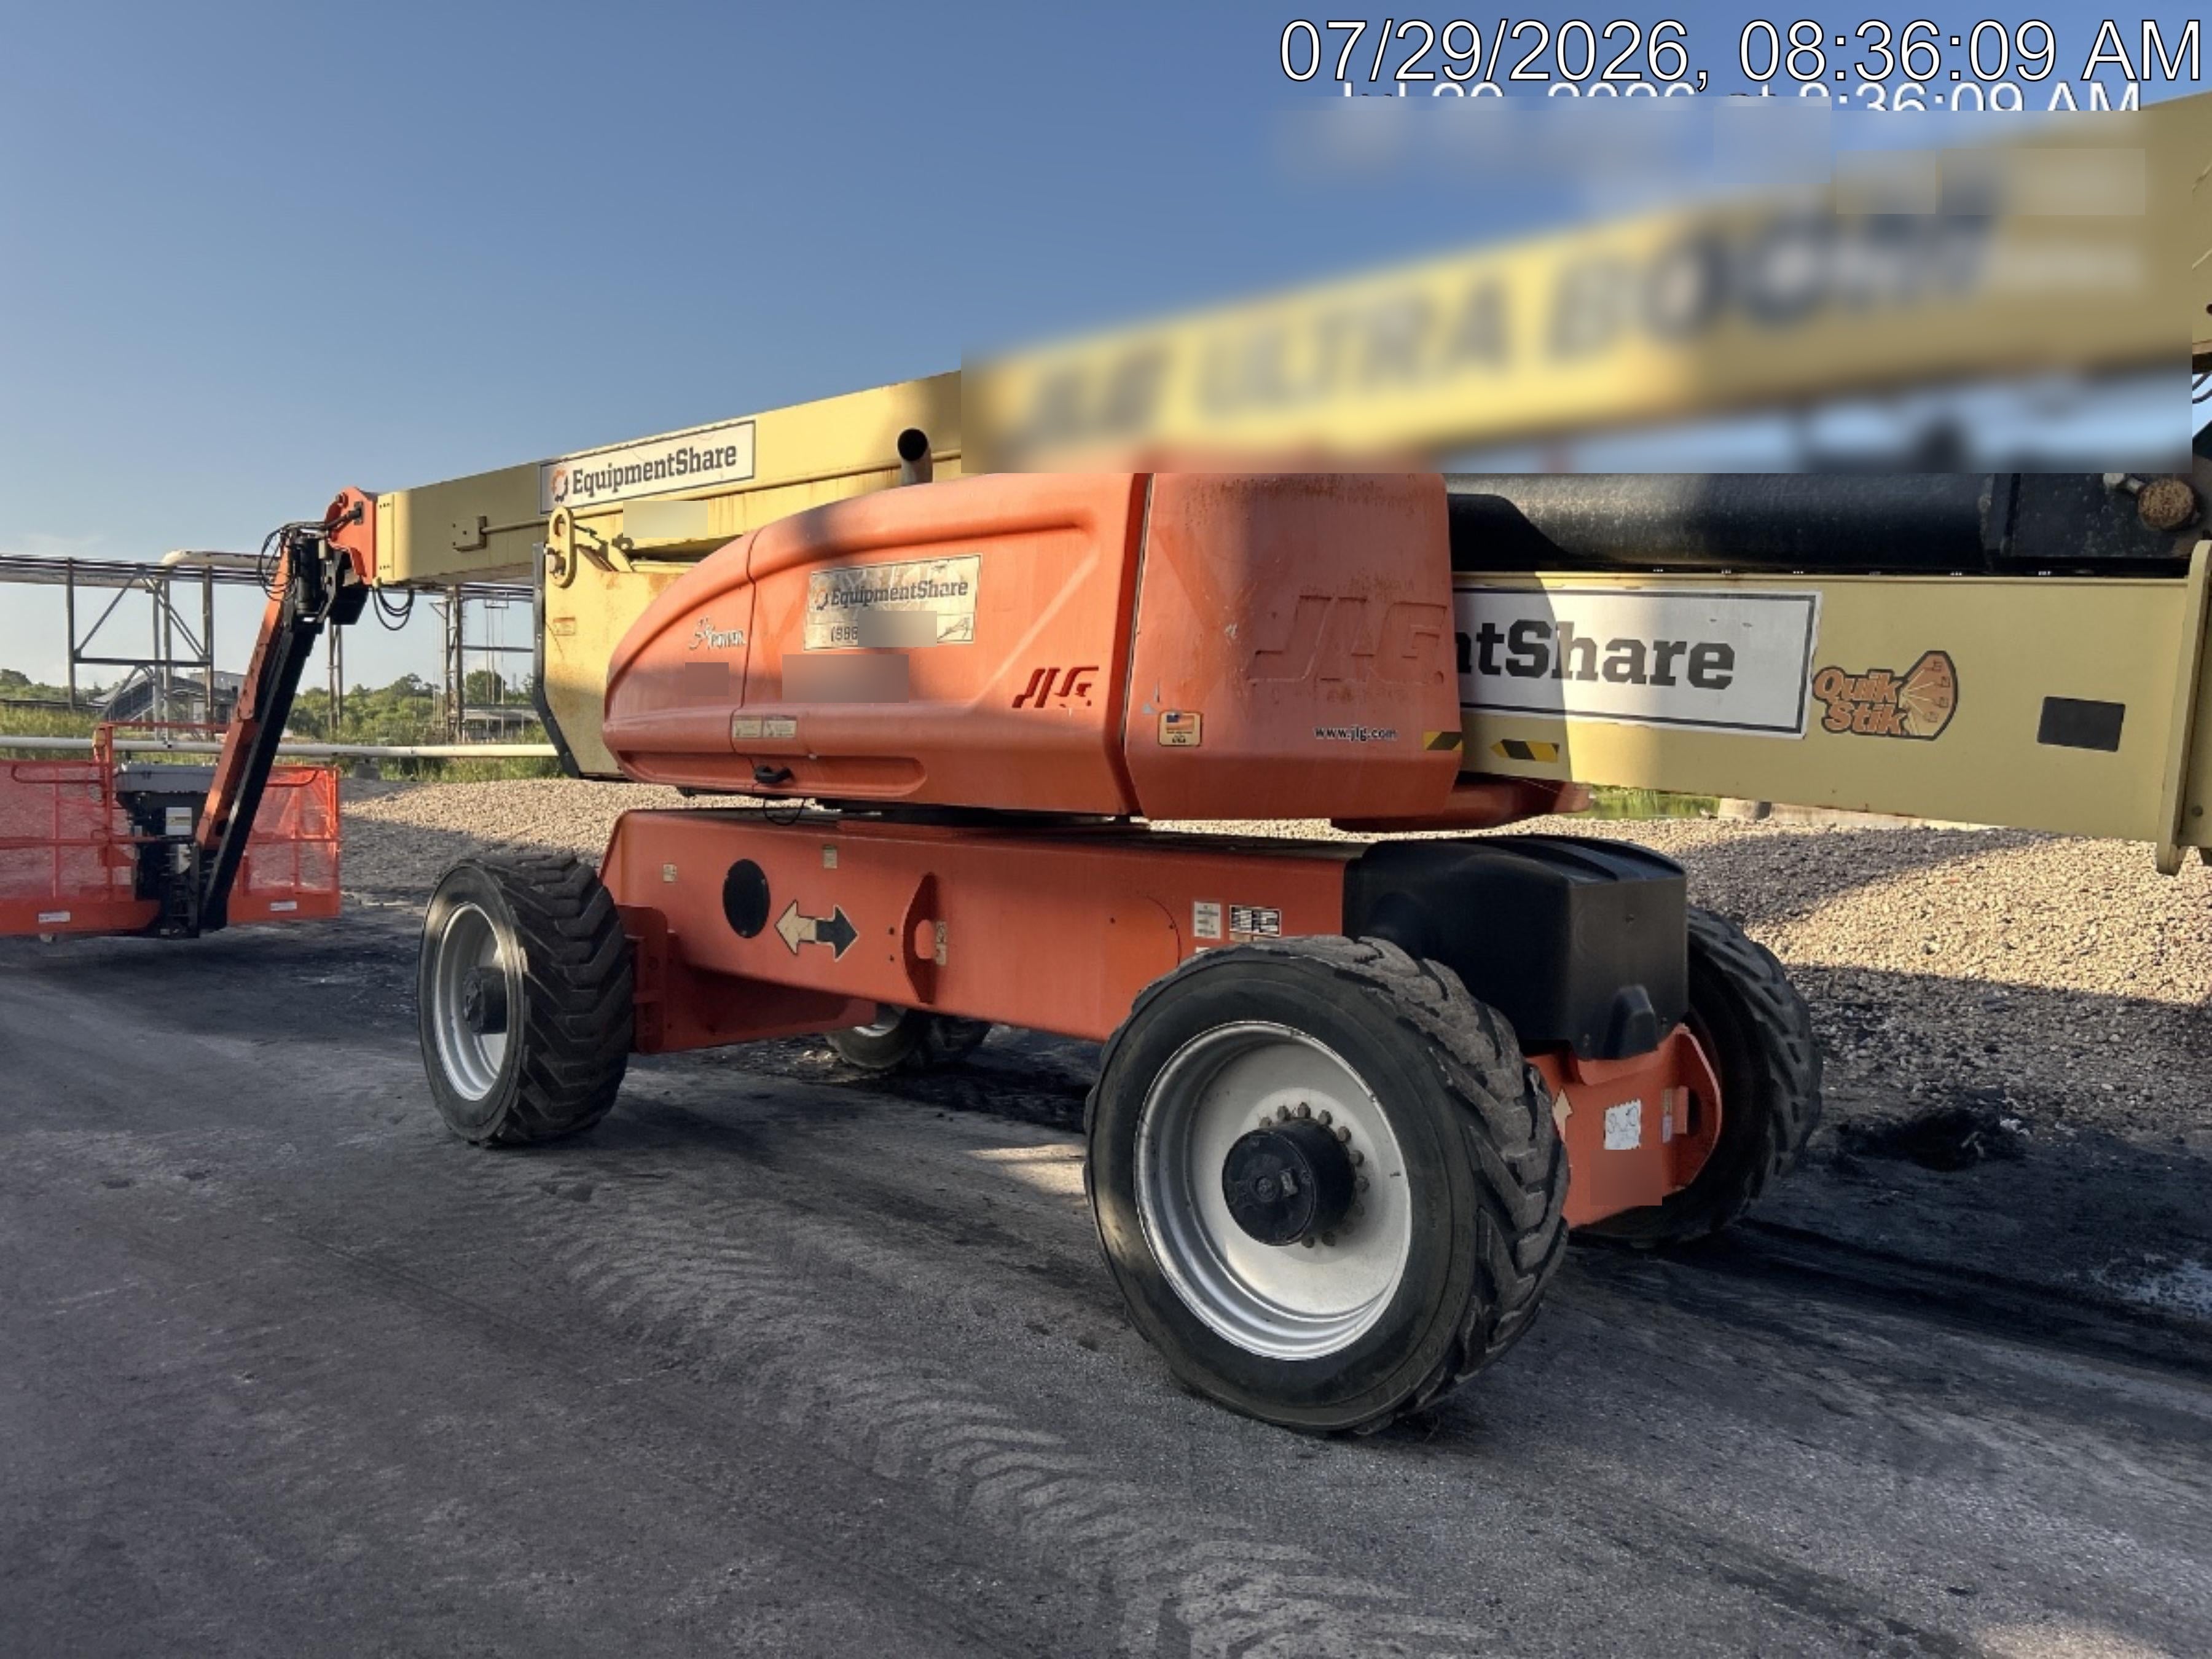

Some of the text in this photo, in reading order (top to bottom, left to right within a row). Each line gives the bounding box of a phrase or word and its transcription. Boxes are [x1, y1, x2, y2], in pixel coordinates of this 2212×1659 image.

[572, 445, 737, 498] EquipmentShare
[830, 579, 968, 609] EquipmentShare
[1314, 725, 1398, 742] www.jlg.com
